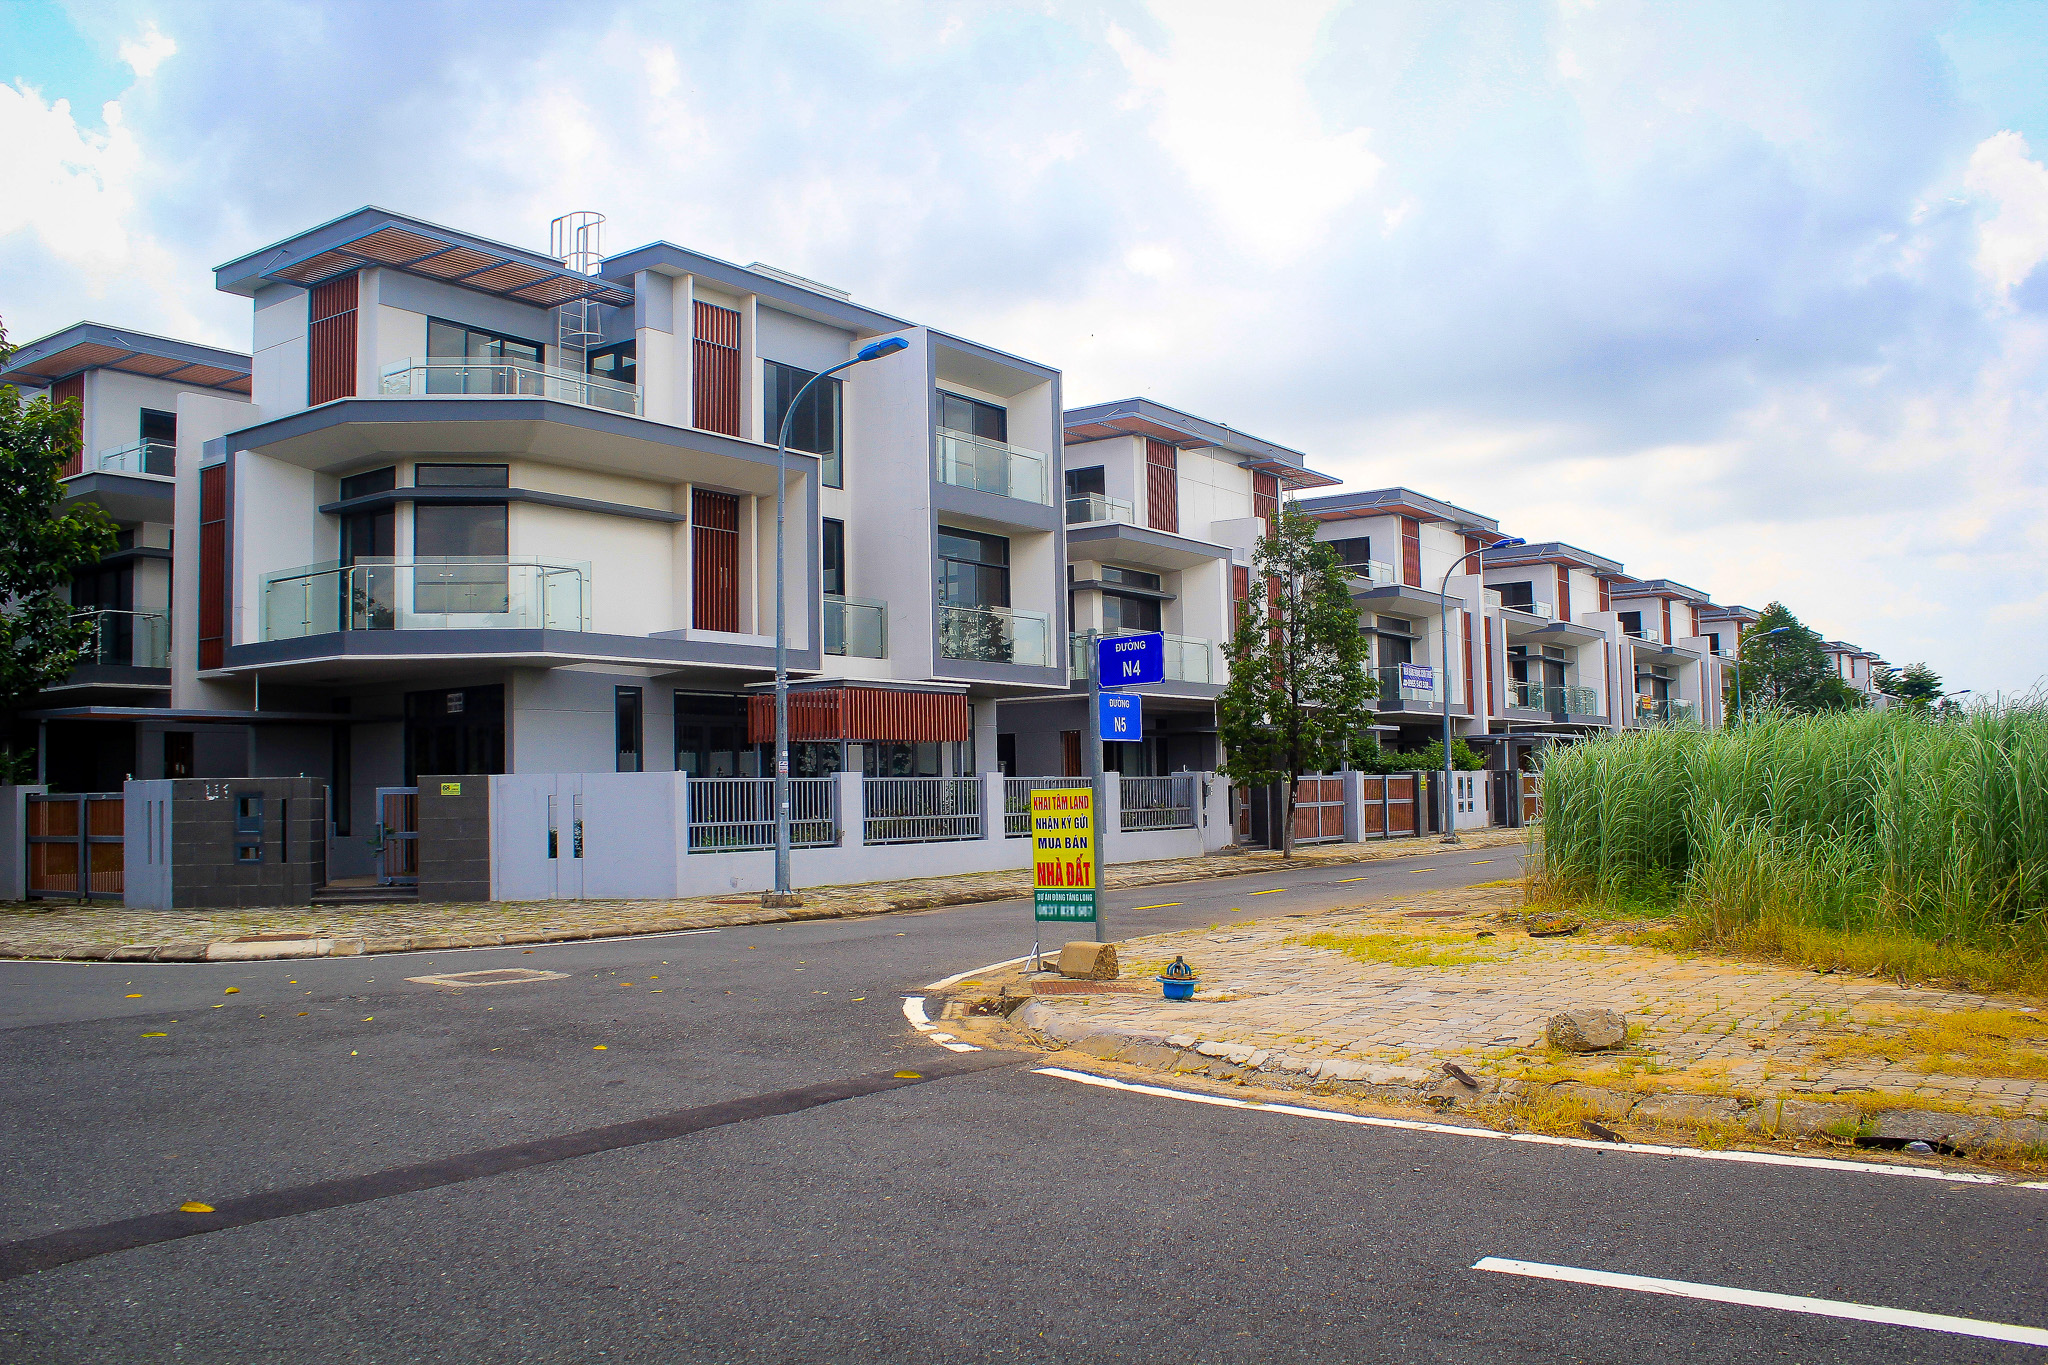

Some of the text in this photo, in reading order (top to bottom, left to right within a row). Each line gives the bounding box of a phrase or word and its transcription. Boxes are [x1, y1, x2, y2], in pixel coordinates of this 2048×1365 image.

[1115, 639, 1146, 653] ĐƯỜNG
[1122, 660, 1141, 677] N4
[1109, 696, 1130, 708] ĐƯỜNG
[1114, 717, 1127, 732] N5
[1033, 794, 1089, 810] KHAI TÂM LAND
[1036, 813, 1089, 832] NHẬN KÝ GỬI
[1038, 835, 1087, 849] MUA BÁN
[1037, 853, 1091, 886] NHÀ ĐẤT
